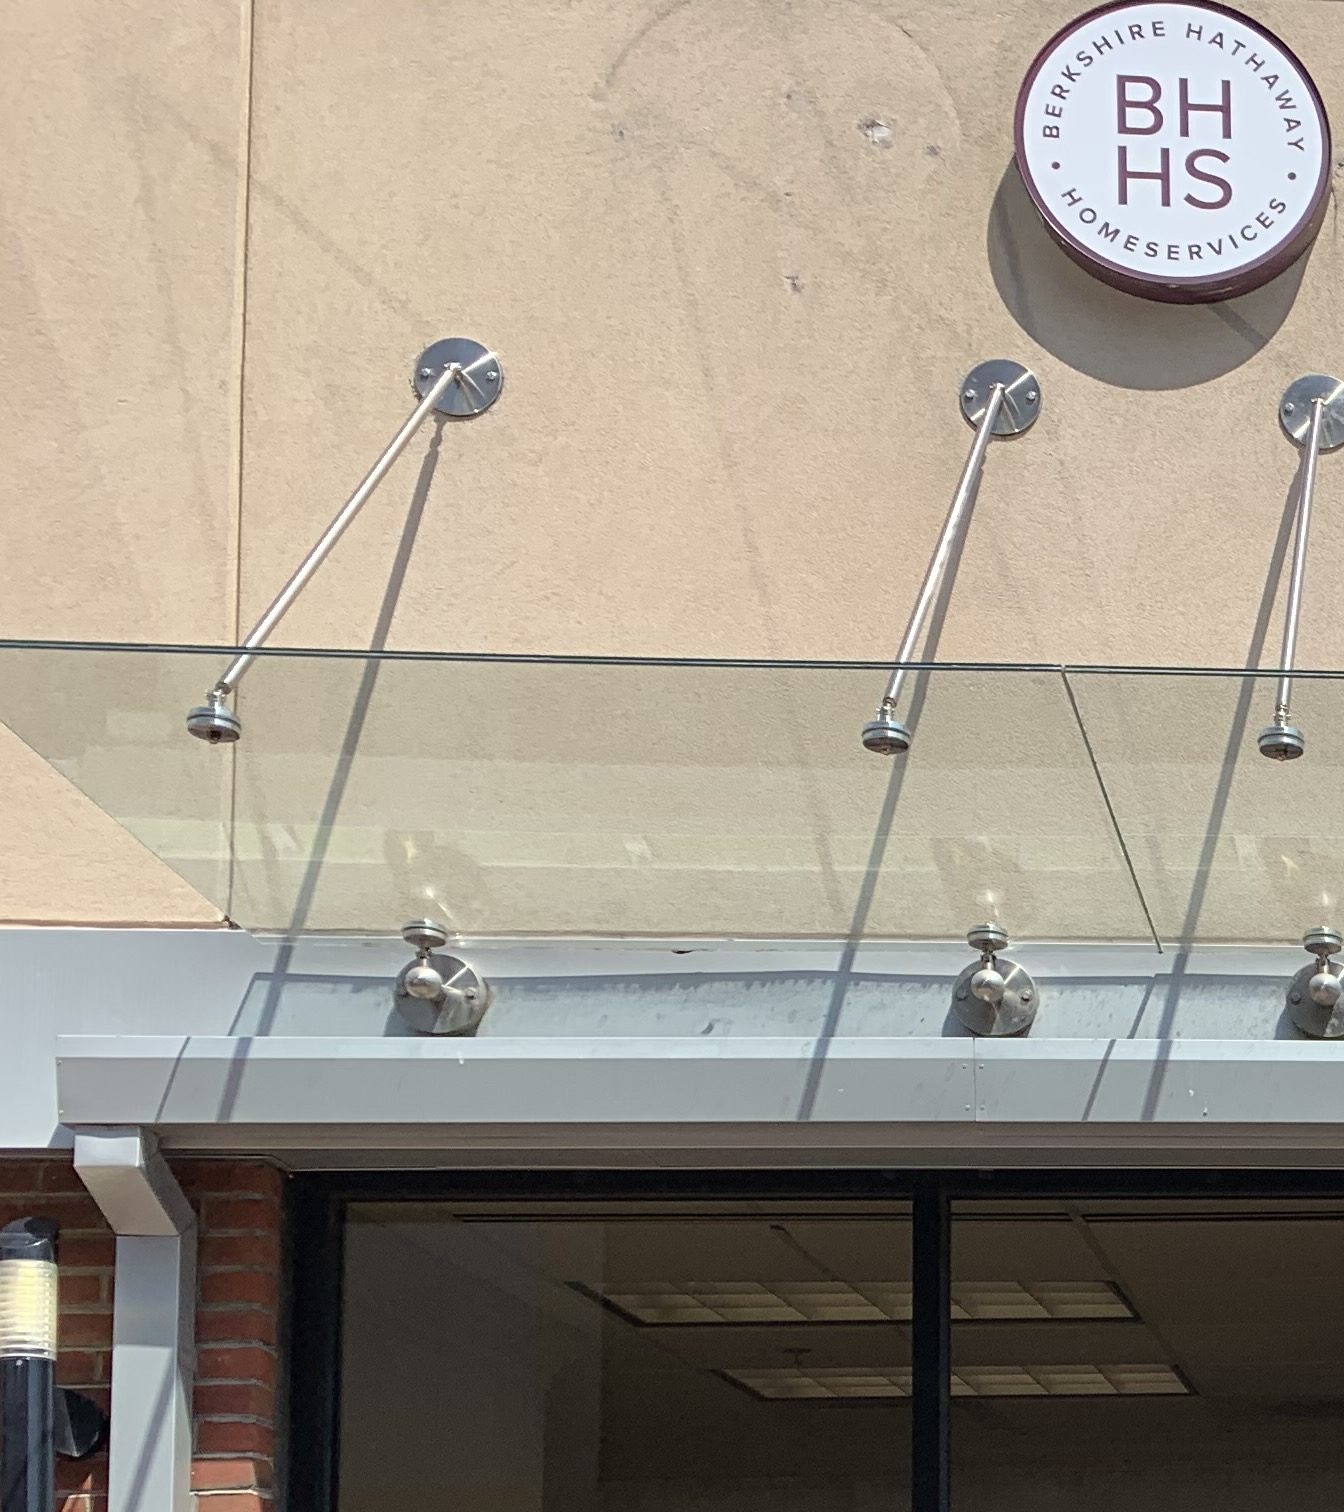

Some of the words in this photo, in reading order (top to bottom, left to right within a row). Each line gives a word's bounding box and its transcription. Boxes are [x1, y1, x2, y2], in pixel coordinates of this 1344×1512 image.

[1042, 20, 1166, 139] BERKSHIRE
[1186, 22, 1305, 152] HATHAWAY
[1116, 74, 1233, 140] BH
[1116, 145, 1233, 211] HS
[1060, 187, 1287, 261] HOMESERVICES
